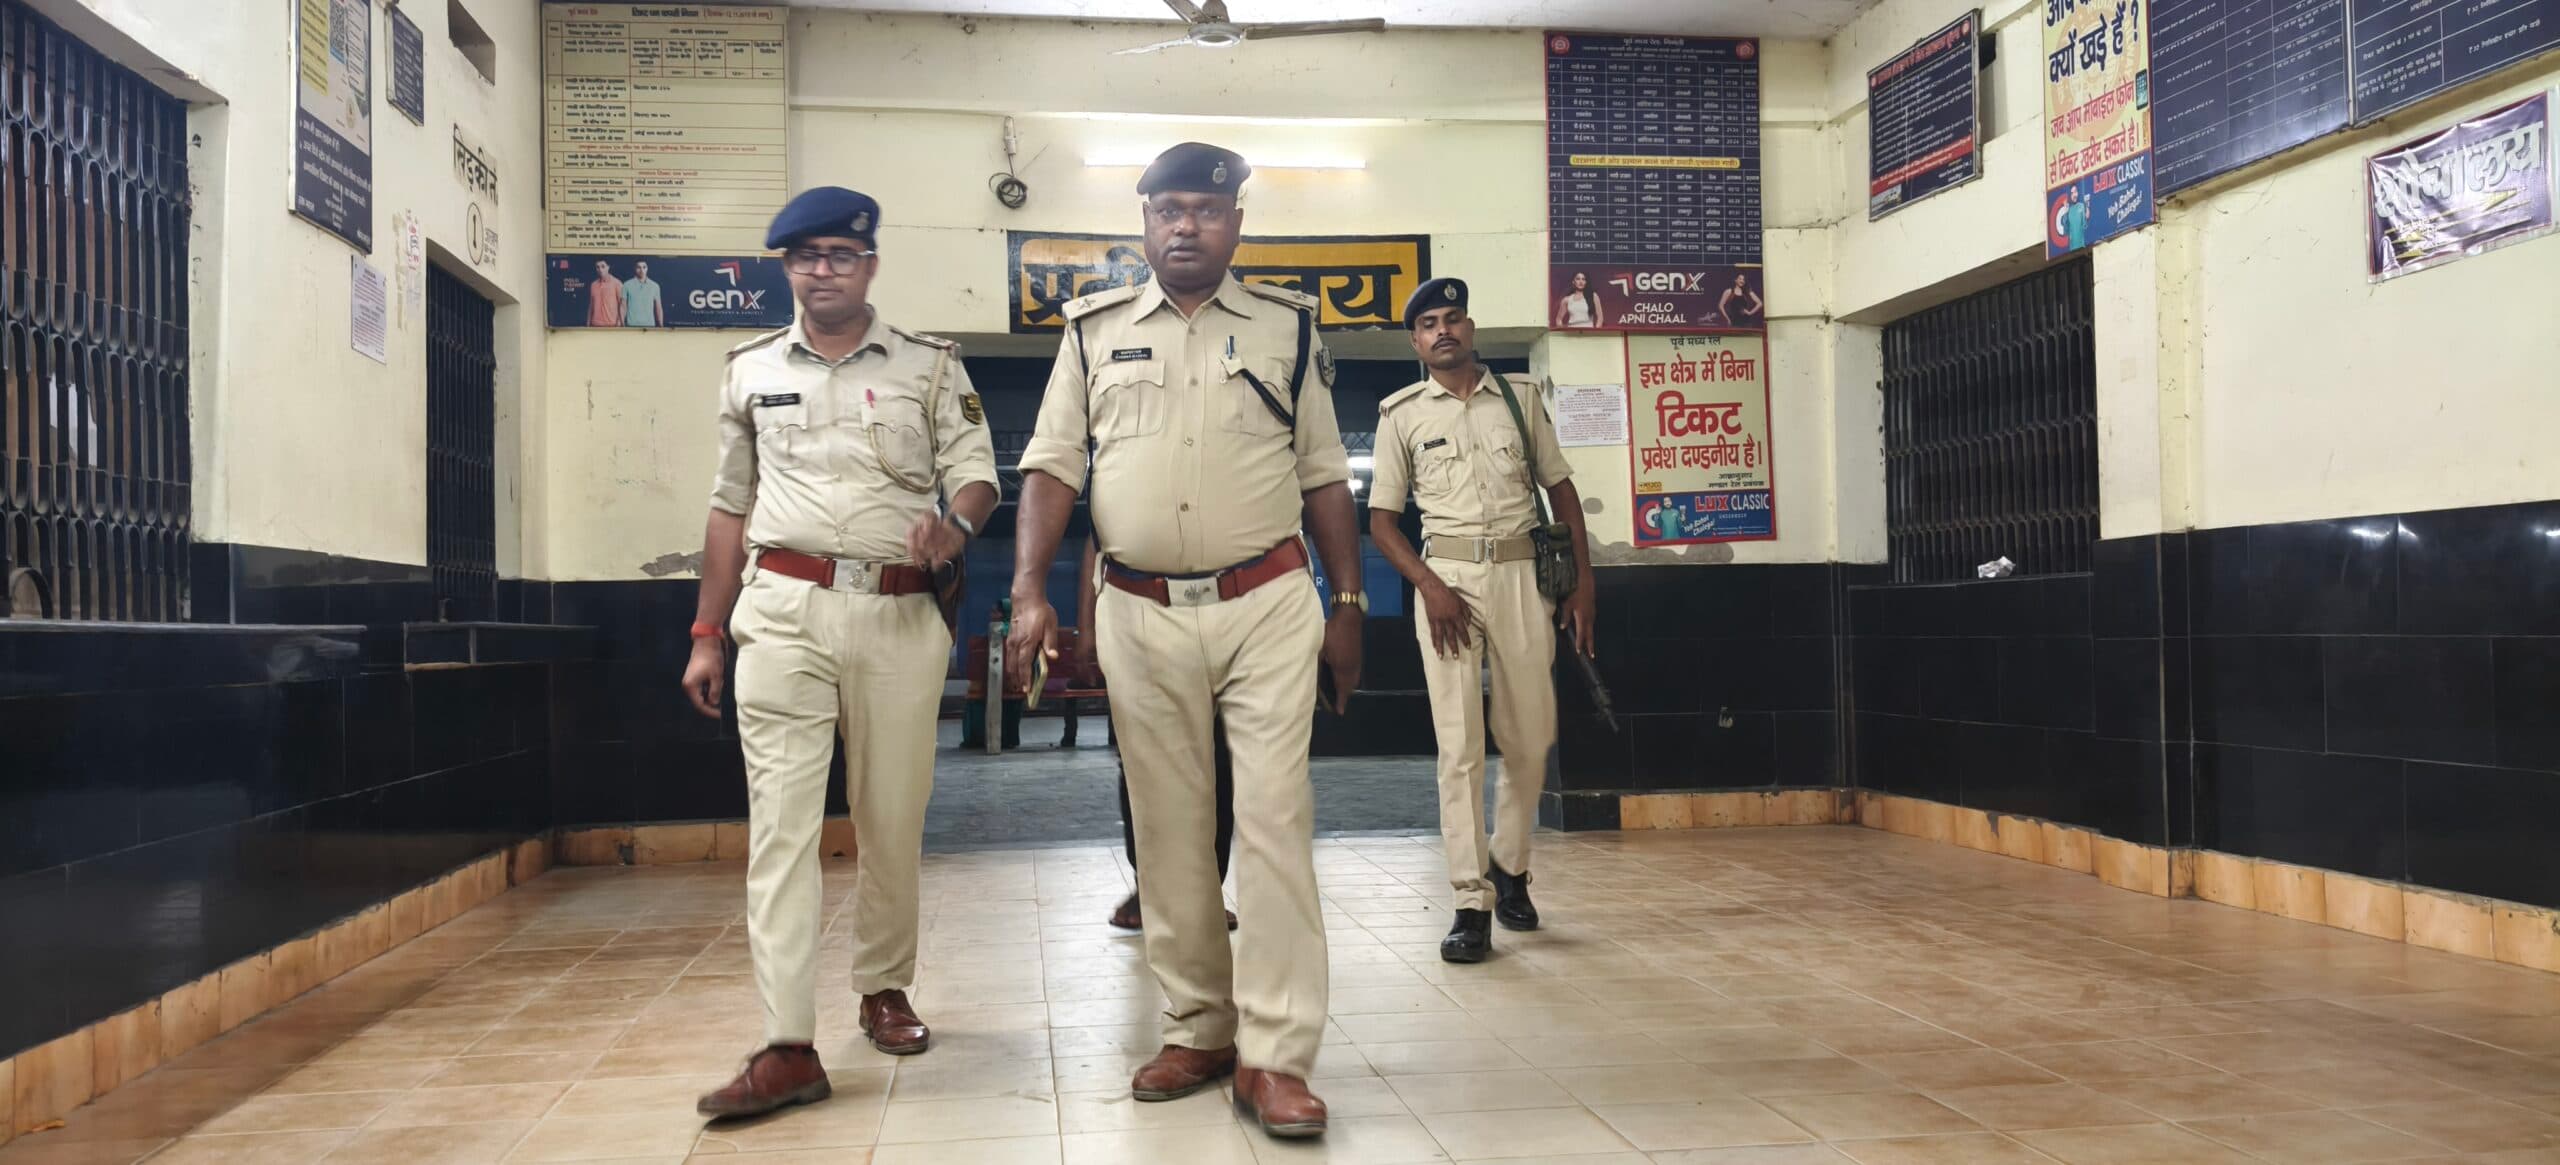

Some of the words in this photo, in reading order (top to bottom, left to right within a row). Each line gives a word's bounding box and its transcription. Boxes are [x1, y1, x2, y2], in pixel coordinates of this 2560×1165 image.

[2048, 28, 2077, 83] क्यों
[2079, 13, 2108, 72] खड़े
[2117, 156, 2145, 184] CLASSIC
[1618, 314, 1646, 324] APNI
[1648, 313, 1687, 324] CHAAL
[1634, 302, 1674, 313] CHALO
[1638, 362, 1666, 388] इस
[1671, 352, 1697, 383] क्षेत्र
[1701, 352, 1718, 382] में
[1720, 350, 1755, 382] बिना
[1655, 390, 1743, 437] टिकट
[1641, 439, 1677, 474] प्रवेश
[1681, 434, 1740, 469] दण्डनीय
[1695, 495, 1729, 512] LUX
[1731, 493, 1770, 511] CLASSIC
